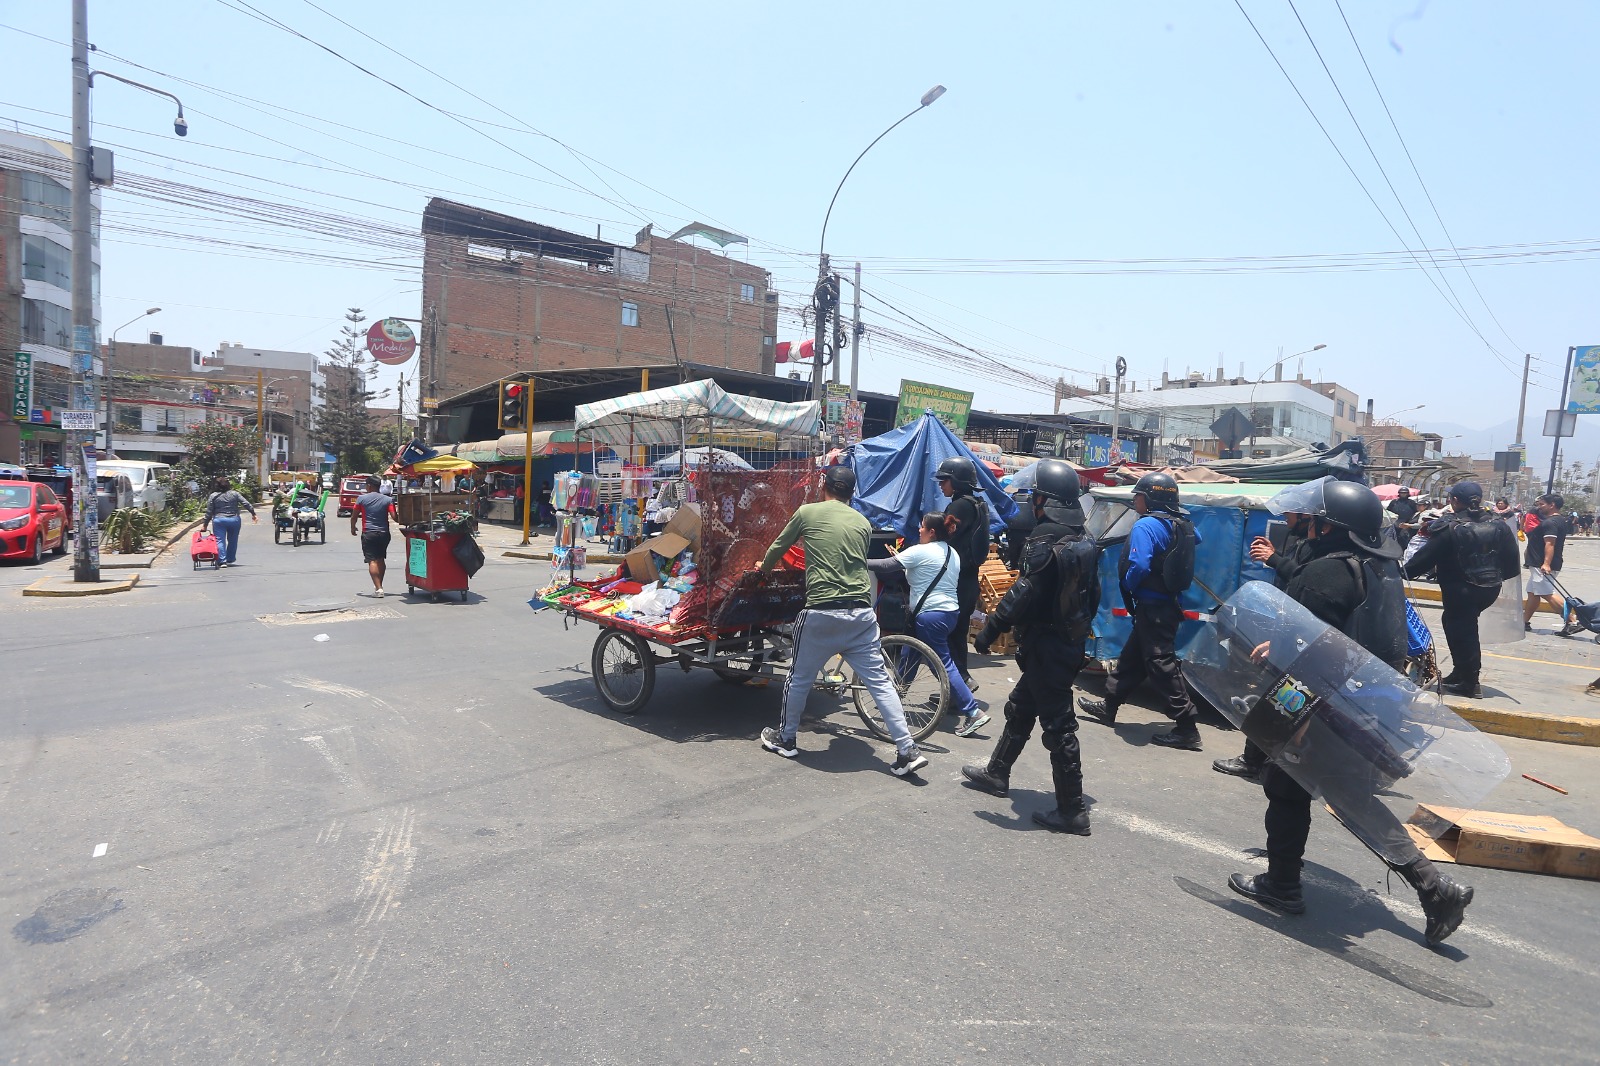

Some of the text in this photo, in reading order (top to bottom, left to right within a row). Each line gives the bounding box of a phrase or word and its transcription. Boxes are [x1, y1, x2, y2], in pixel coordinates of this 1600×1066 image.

[15, 361, 29, 416] BOTICAS
[904, 394, 919, 409] LOS
[63, 412, 93, 420] CURANDERA
[1090, 446, 1106, 463] LOS
